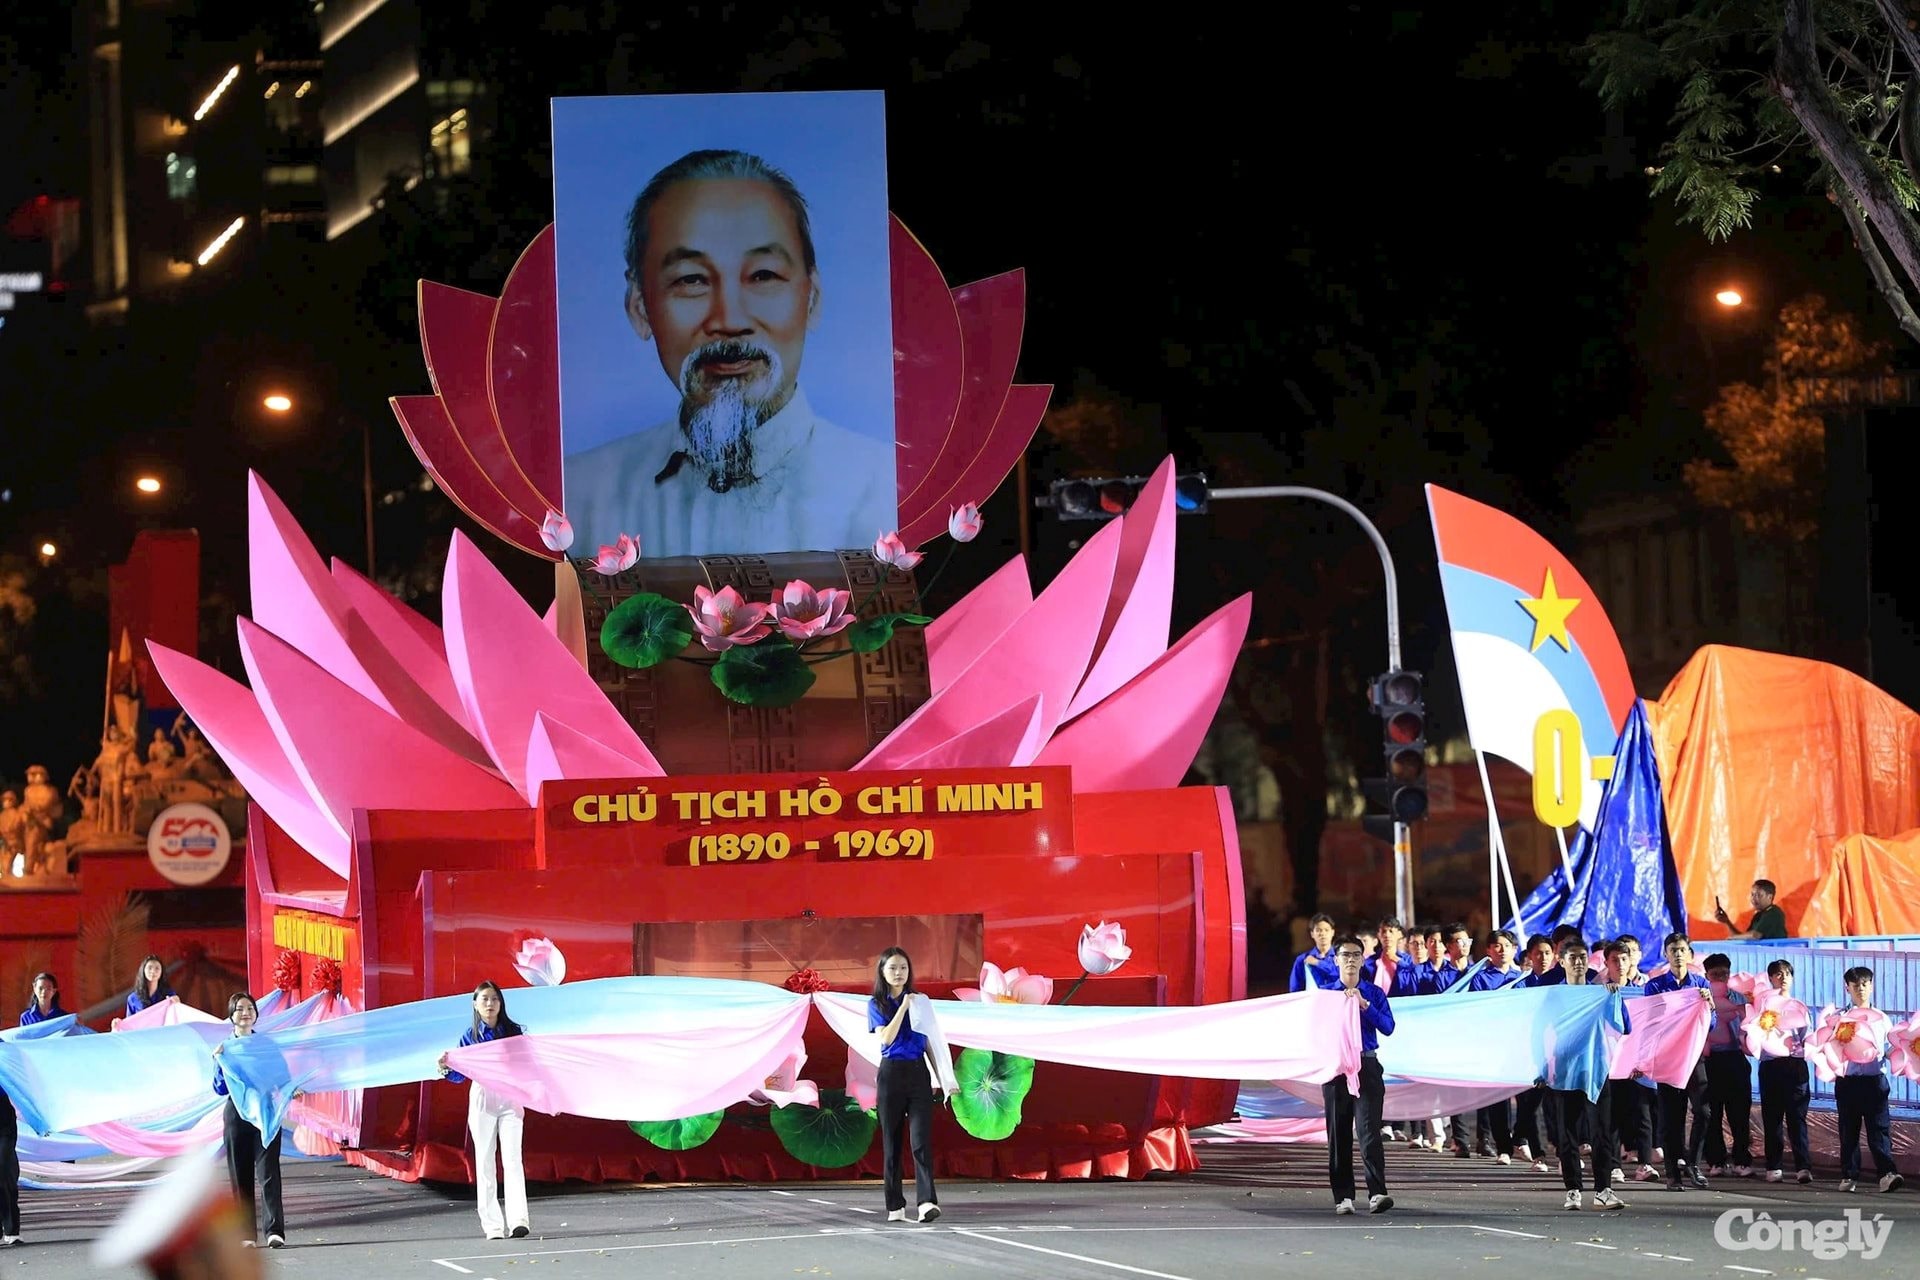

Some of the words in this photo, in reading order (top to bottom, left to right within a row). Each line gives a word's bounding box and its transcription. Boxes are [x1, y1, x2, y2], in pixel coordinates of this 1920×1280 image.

[572, 786, 657, 823] CHỦ
[672, 791, 766, 826] TỊCH
[779, 777, 843, 816] HỒ
[857, 778, 924, 815] CHÍ
[938, 782, 1043, 812] MINH
[689, 832, 791, 867] (1890
[833, 829, 935, 861] 1969)
